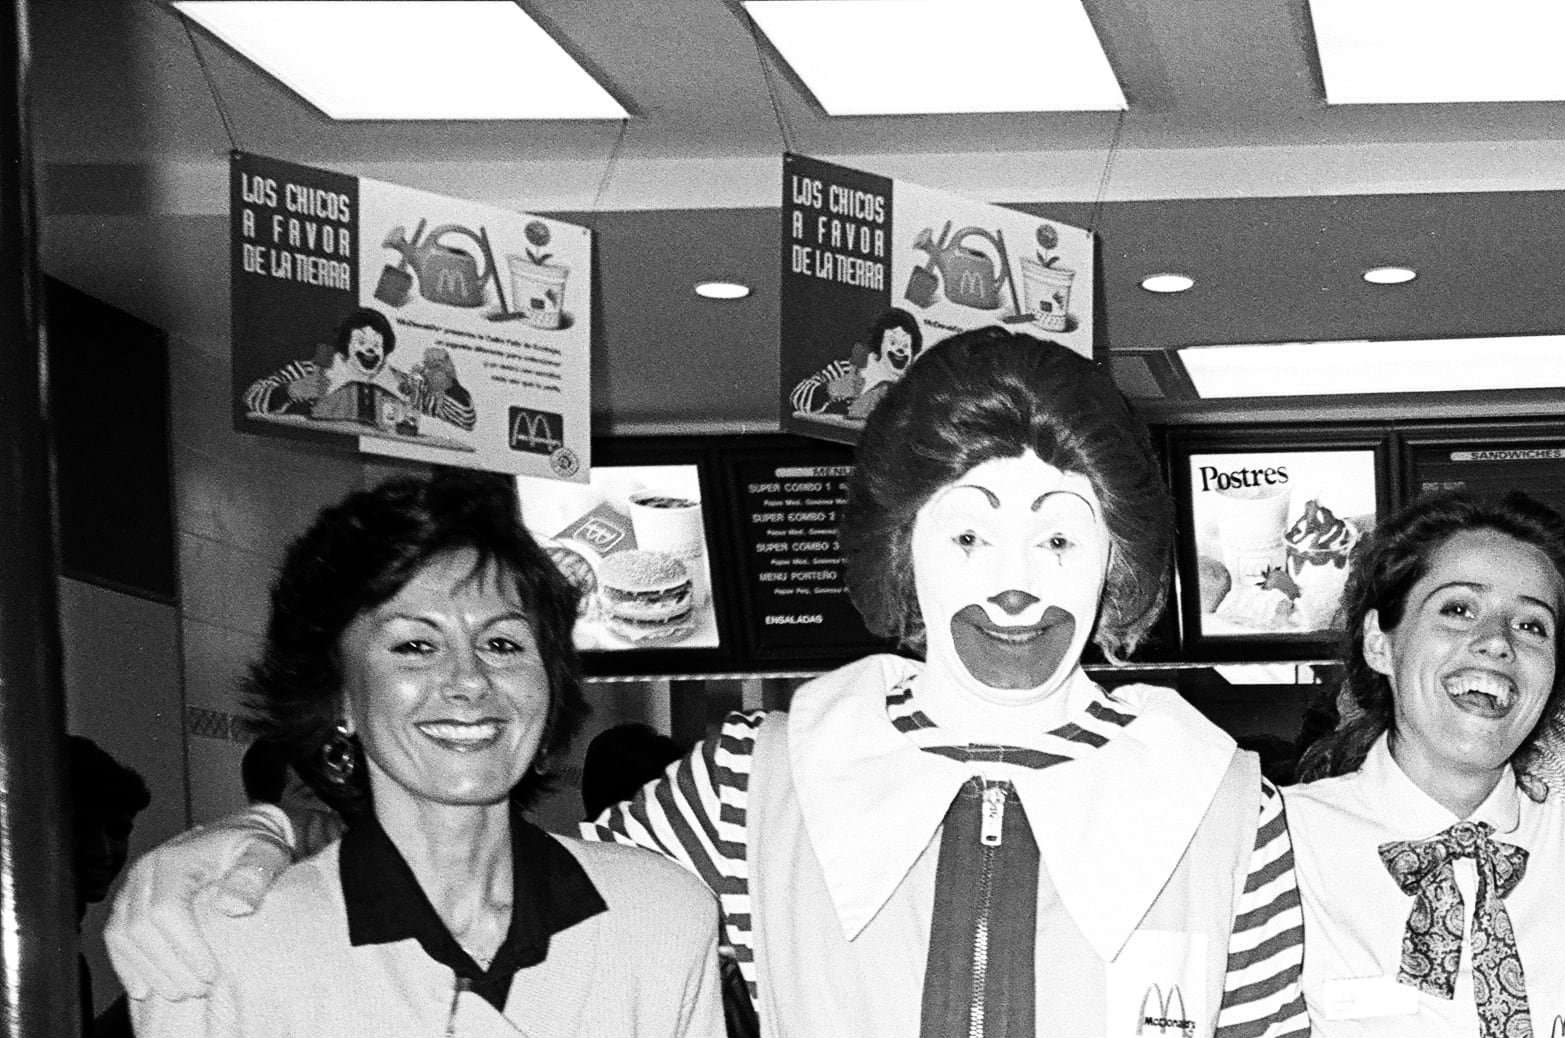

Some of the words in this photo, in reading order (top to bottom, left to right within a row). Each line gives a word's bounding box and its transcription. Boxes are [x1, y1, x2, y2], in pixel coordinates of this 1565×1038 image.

[242, 173, 277, 208] LOS
[285, 183, 350, 222] CHICOS
[792, 175, 822, 209] LOS
[829, 184, 885, 223] CHICOS
[243, 208, 255, 239] A
[273, 214, 350, 258] FAVOR
[793, 211, 803, 240] A
[818, 216, 884, 258] FAVOR
[243, 243, 265, 275] DE
[270, 248, 291, 280] LA
[292, 252, 351, 292] TIERRA
[792, 244, 812, 276] DE
[815, 249, 832, 279] LA
[833, 252, 884, 292] TIERRA
[1199, 466, 1289, 491] Postres
[1471, 450, 1562, 460] SANDWICHES
[765, 614, 823, 625] ENSALADAS
